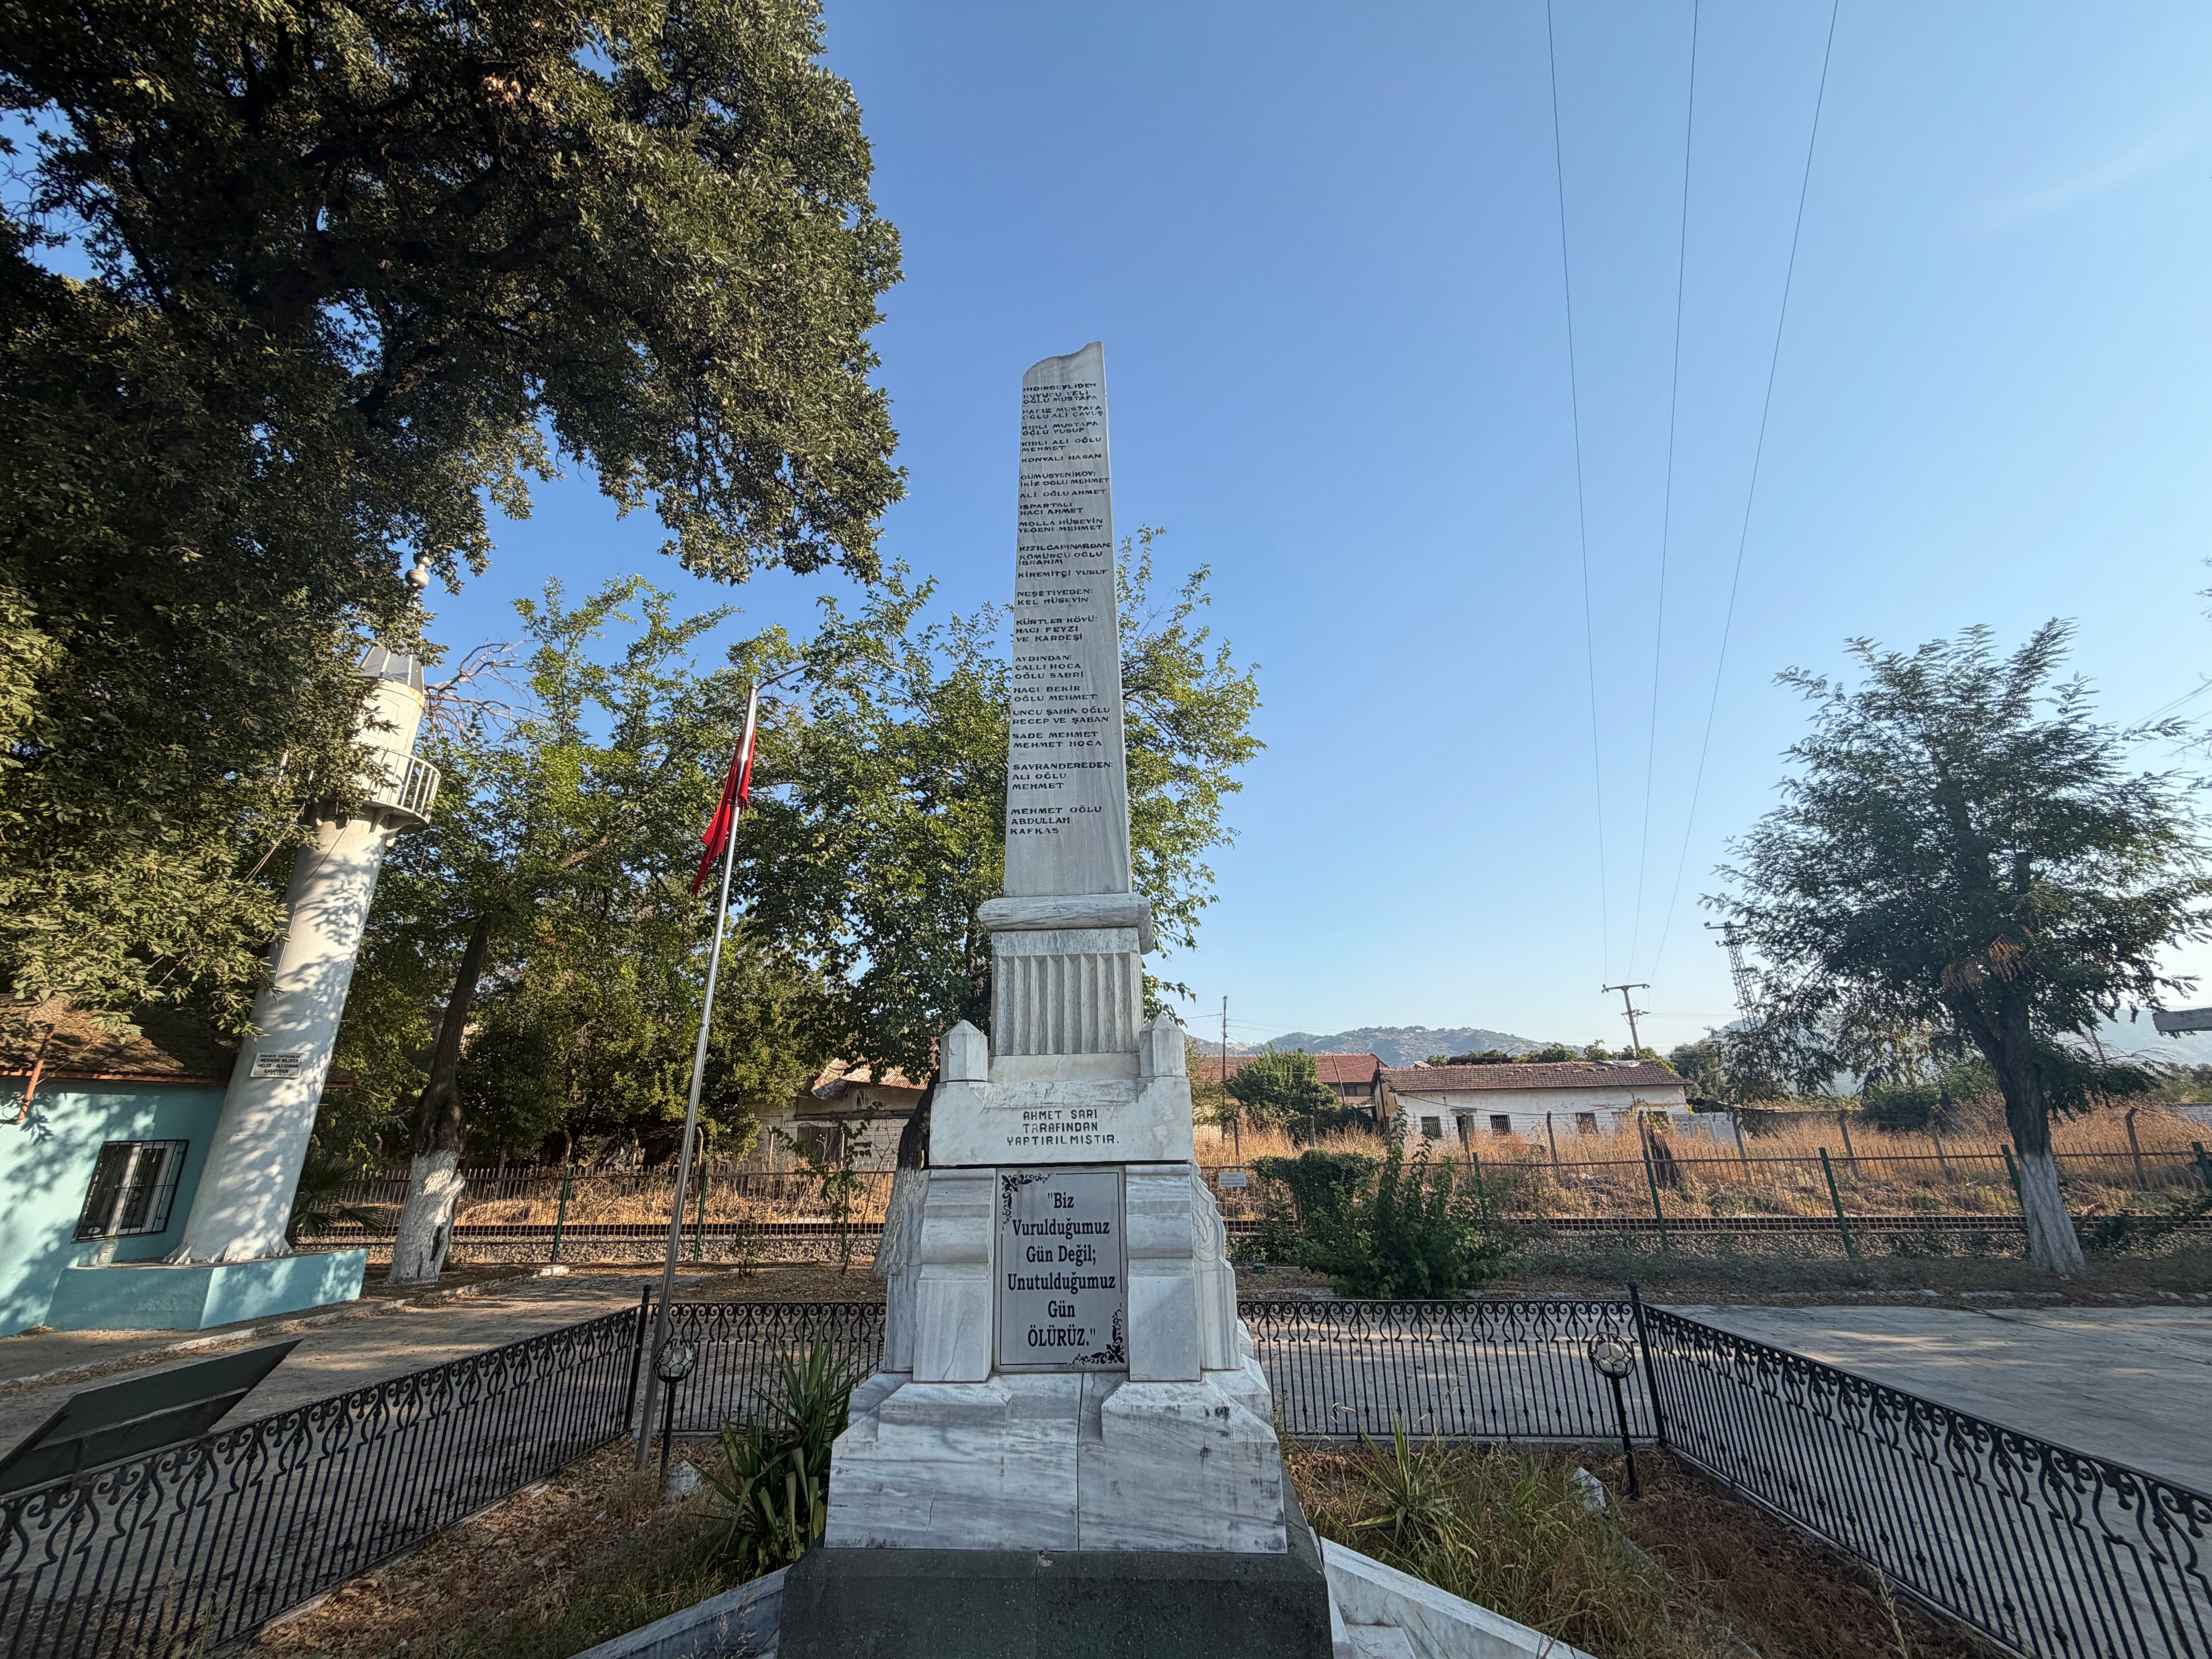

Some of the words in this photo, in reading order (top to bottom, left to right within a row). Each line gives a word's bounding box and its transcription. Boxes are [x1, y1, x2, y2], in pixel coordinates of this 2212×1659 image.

[1018, 570, 1071, 578] KİREMİTÇİ
[1017, 588, 1093, 598] NEŞETİYEDEN:
[1035, 633, 1082, 642] KARDEŞİ
[1046, 707, 1077, 716] ŞAHİN
[1072, 716, 1108, 725] ŞABAN
[1013, 762, 1113, 771] SAVRANDEREDEN:
[1013, 772, 1029, 780] ALİ
[1070, 805, 1102, 813] OĞLU
[1023, 1110, 1062, 1120] AHMET
[1071, 1109, 1097, 1120] SARI
[1023, 1122, 1097, 1133] TARAFINDAN
[1007, 1134, 1119, 1146] YAPTIRILMIŞTIR.
[1048, 1192, 1074, 1209] "Biz
[1012, 1217, 1110, 1240] Vurulduğumuz
[1026, 1246, 1053, 1263] Gün
[1058, 1244, 1096, 1267] Değil;
[1007, 1271, 1116, 1295] Unutulduğumuz
[1048, 1300, 1075, 1318] Gün
[1028, 1324, 1096, 1347] ÖLÜRÜZ."
